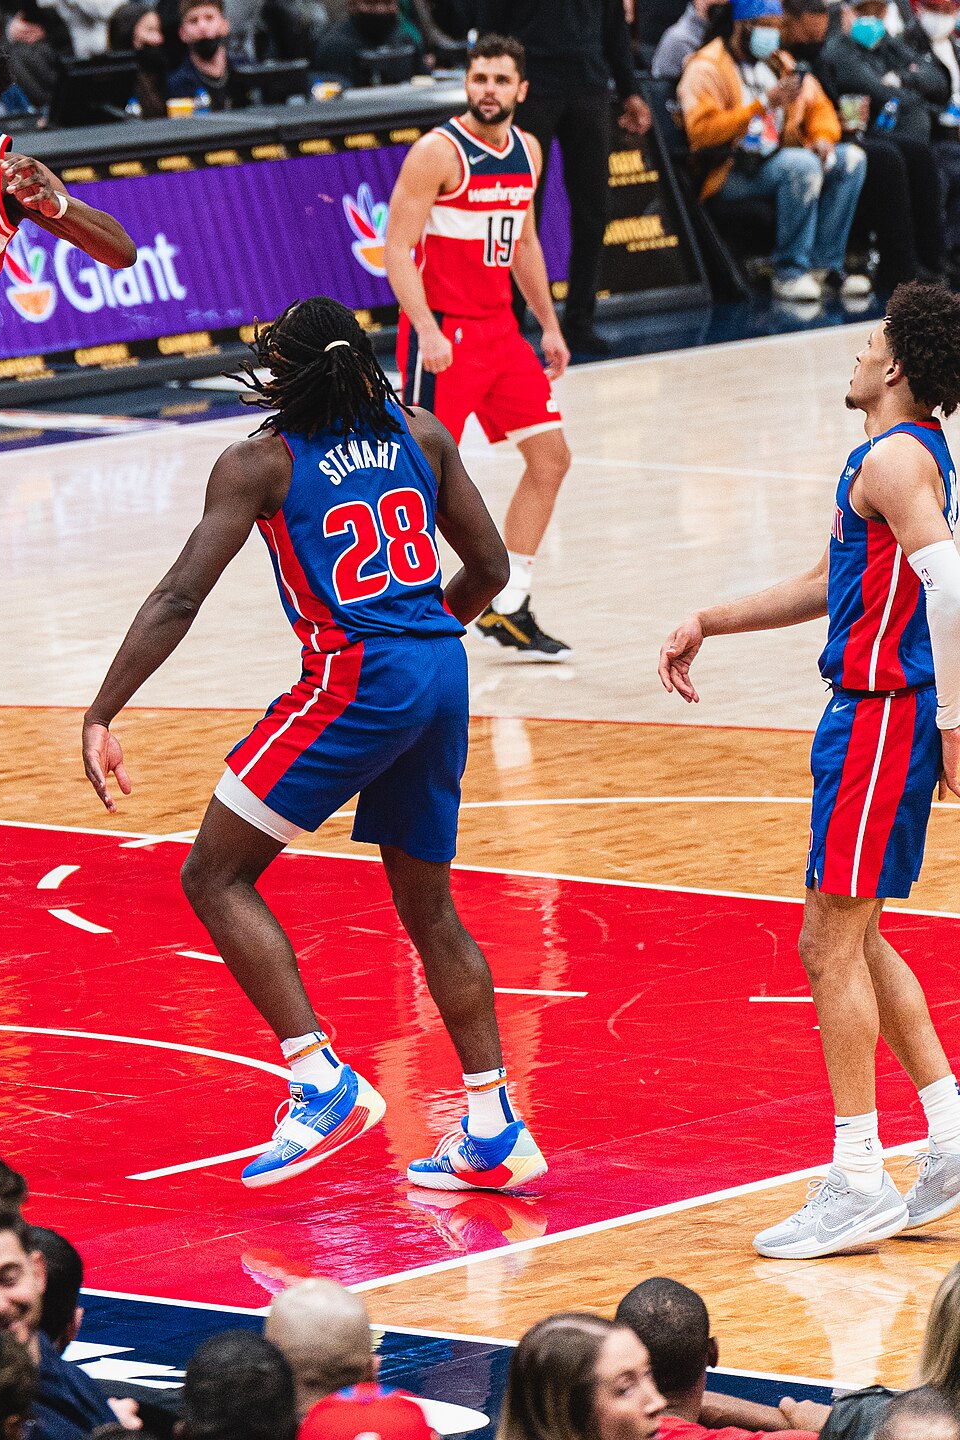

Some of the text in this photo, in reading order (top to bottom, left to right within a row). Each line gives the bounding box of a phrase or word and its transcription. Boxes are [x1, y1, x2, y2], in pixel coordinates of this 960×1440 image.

[485, 215, 516, 265] 19
[319, 439, 401, 486] STEWART
[323, 487, 440, 606] 28
